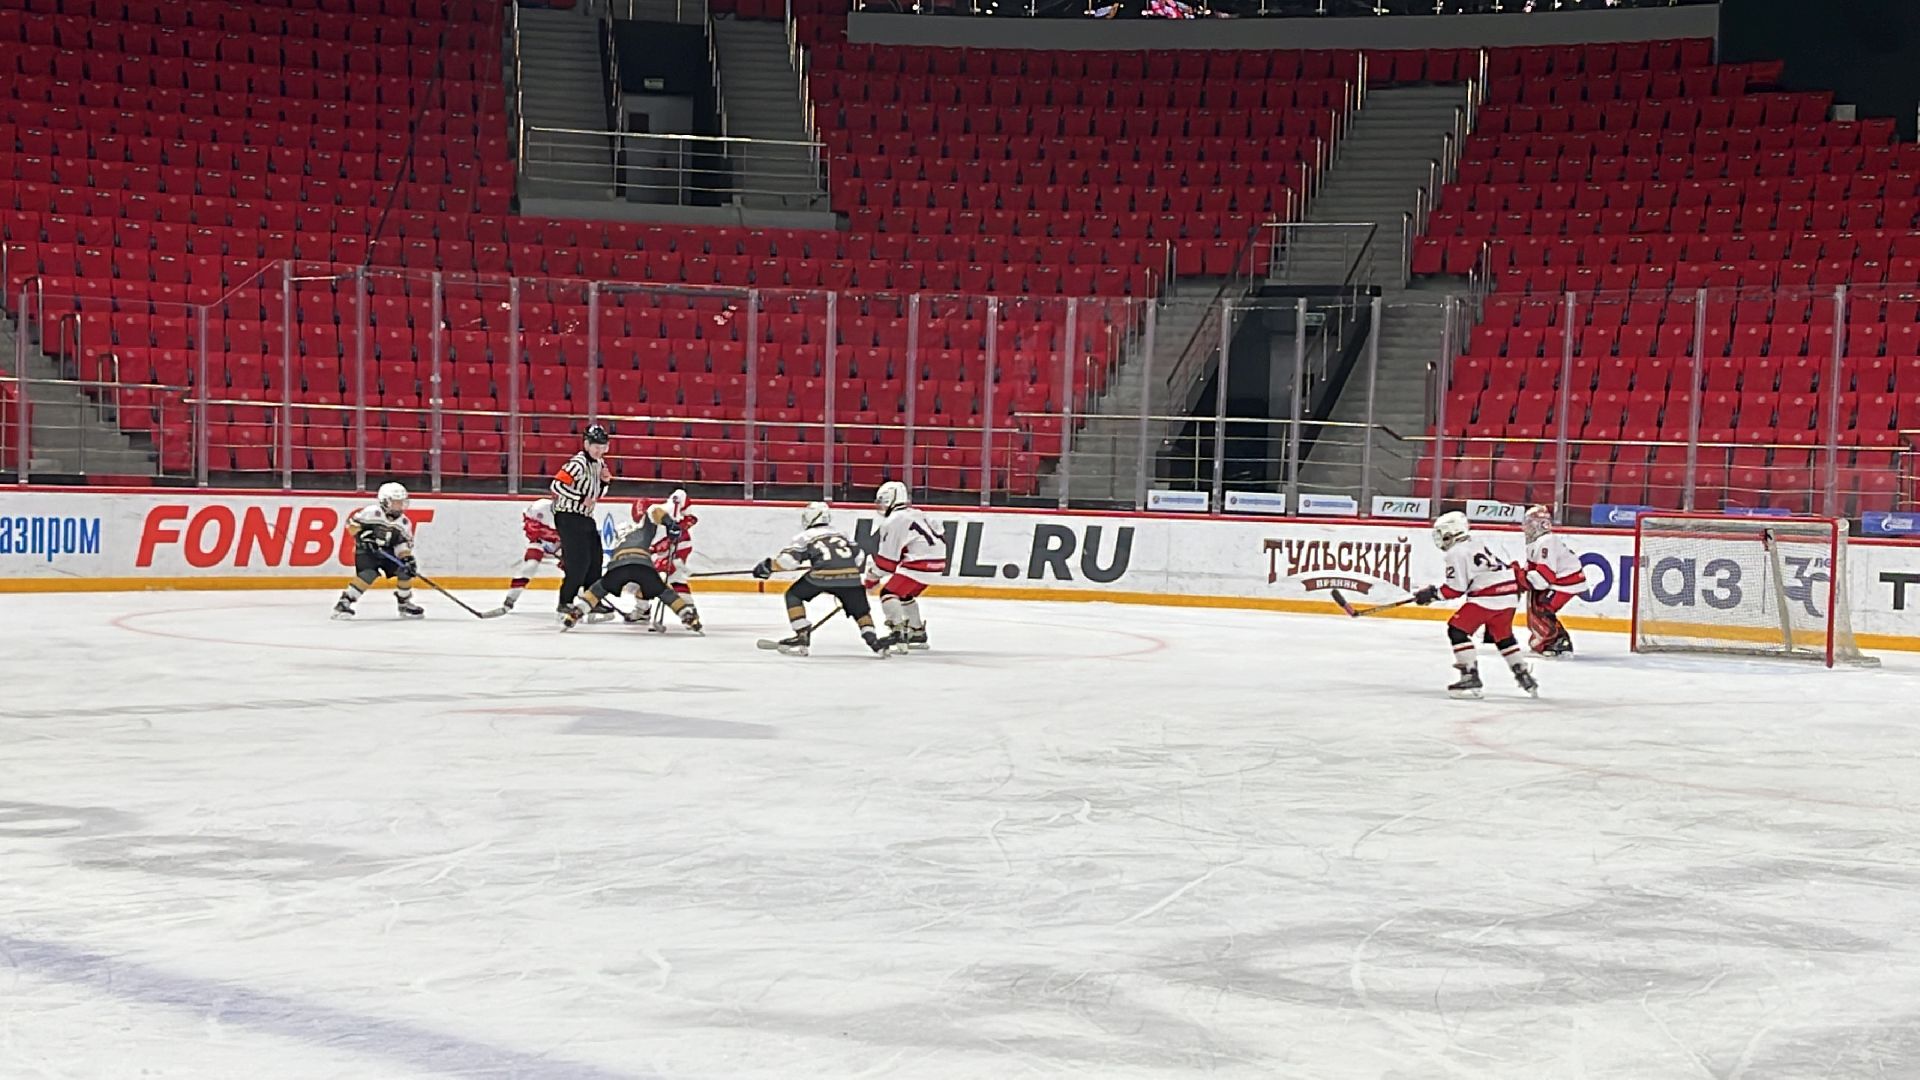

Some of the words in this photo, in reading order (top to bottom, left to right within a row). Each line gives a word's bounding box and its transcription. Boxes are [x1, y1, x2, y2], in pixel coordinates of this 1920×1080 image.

[1382, 502, 1421, 513] PARI
[1475, 505, 1515, 517] PARI
[814, 537, 852, 561] 13
[1263, 535, 1412, 592] ТУЛЬСКИЙ
